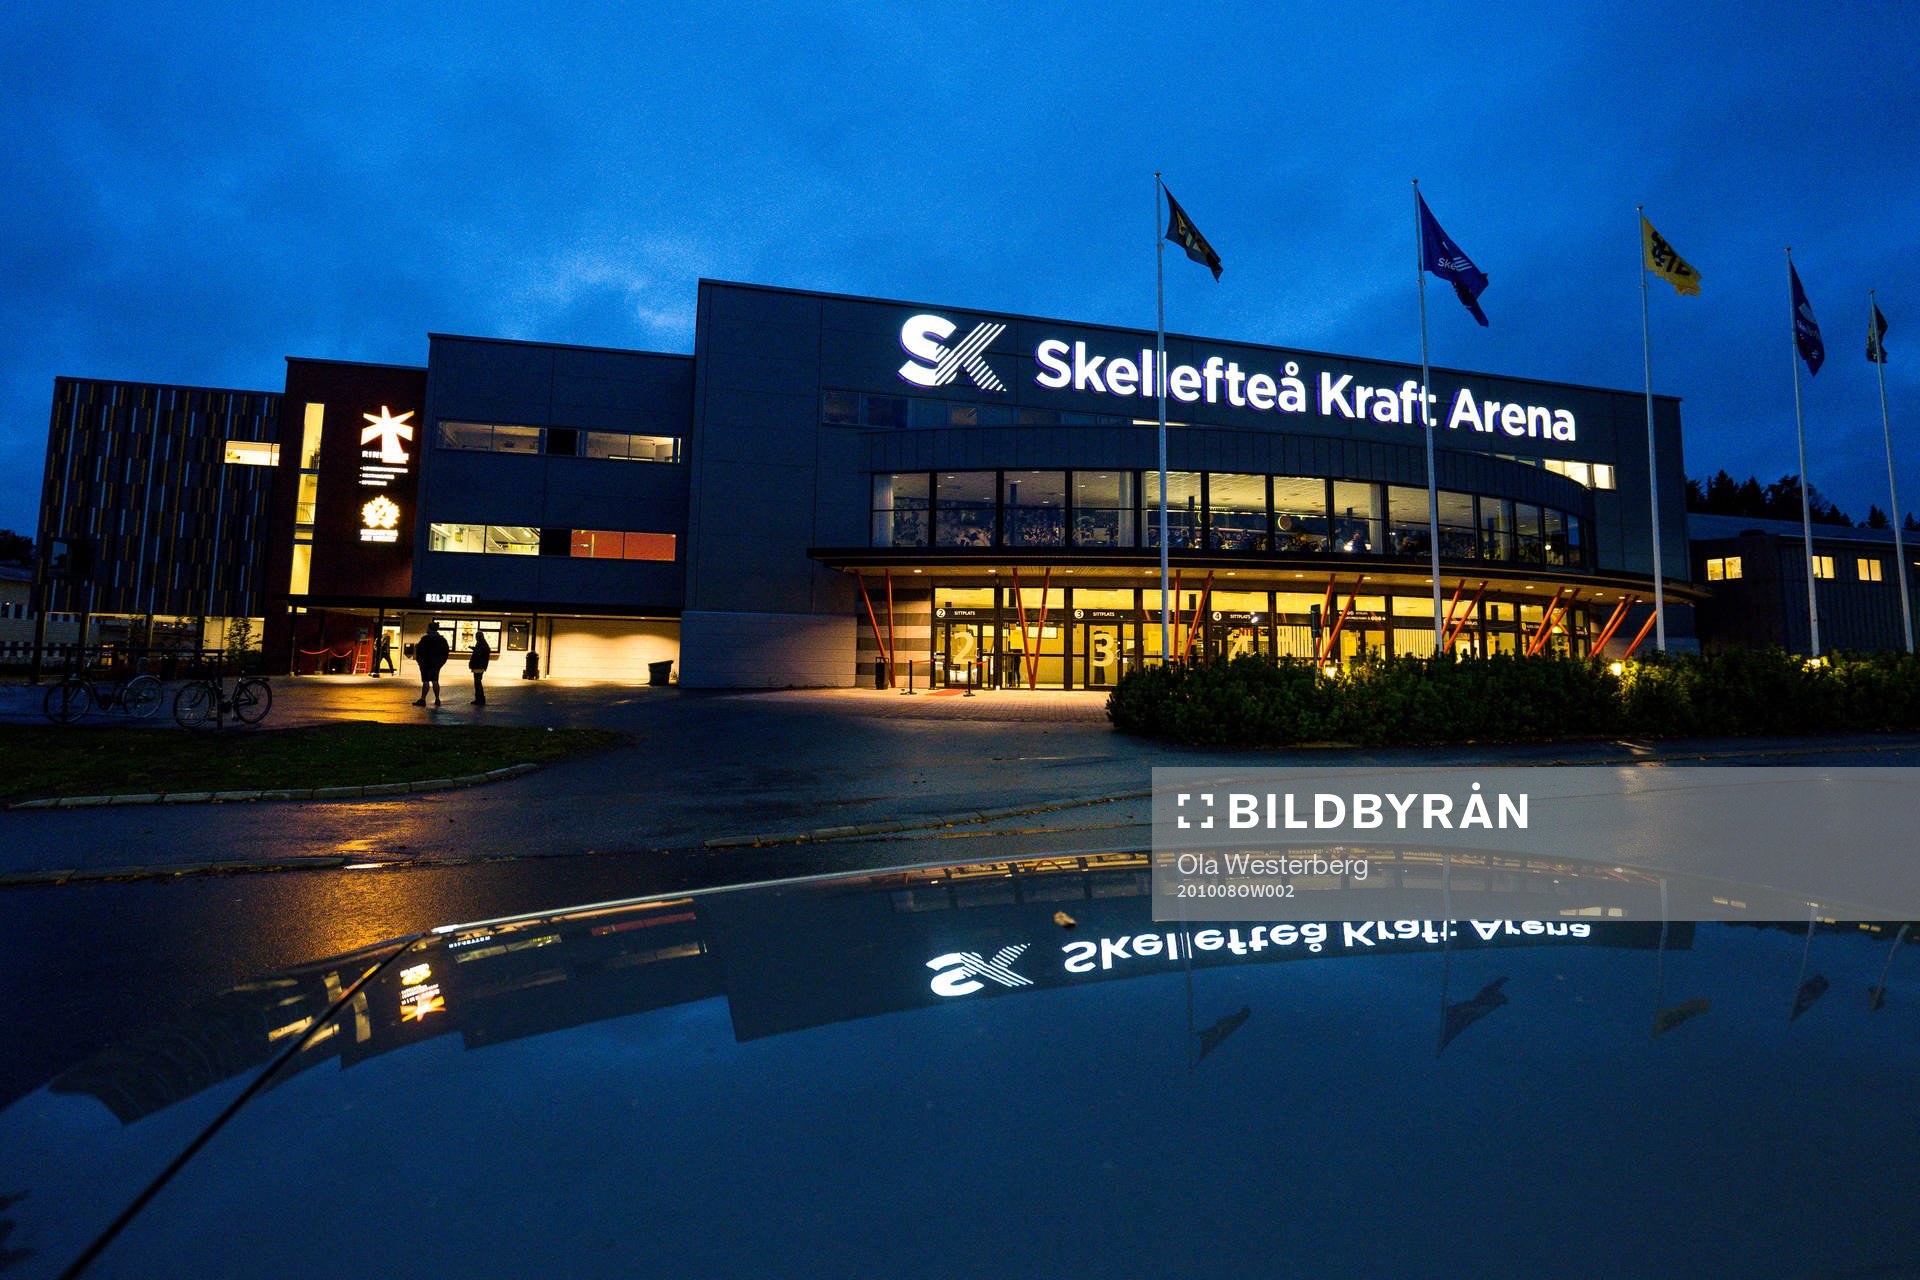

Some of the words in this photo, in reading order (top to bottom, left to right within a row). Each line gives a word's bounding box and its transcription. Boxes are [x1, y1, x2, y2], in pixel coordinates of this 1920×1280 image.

[1036, 340, 1306, 413] Skellefteå
[1321, 372, 1437, 427] Kraft
[1449, 388, 1576, 442] Arena
[425, 593, 473, 604] BILJETTER
[953, 631, 974, 664] 2
[1093, 634, 1114, 667] 3
